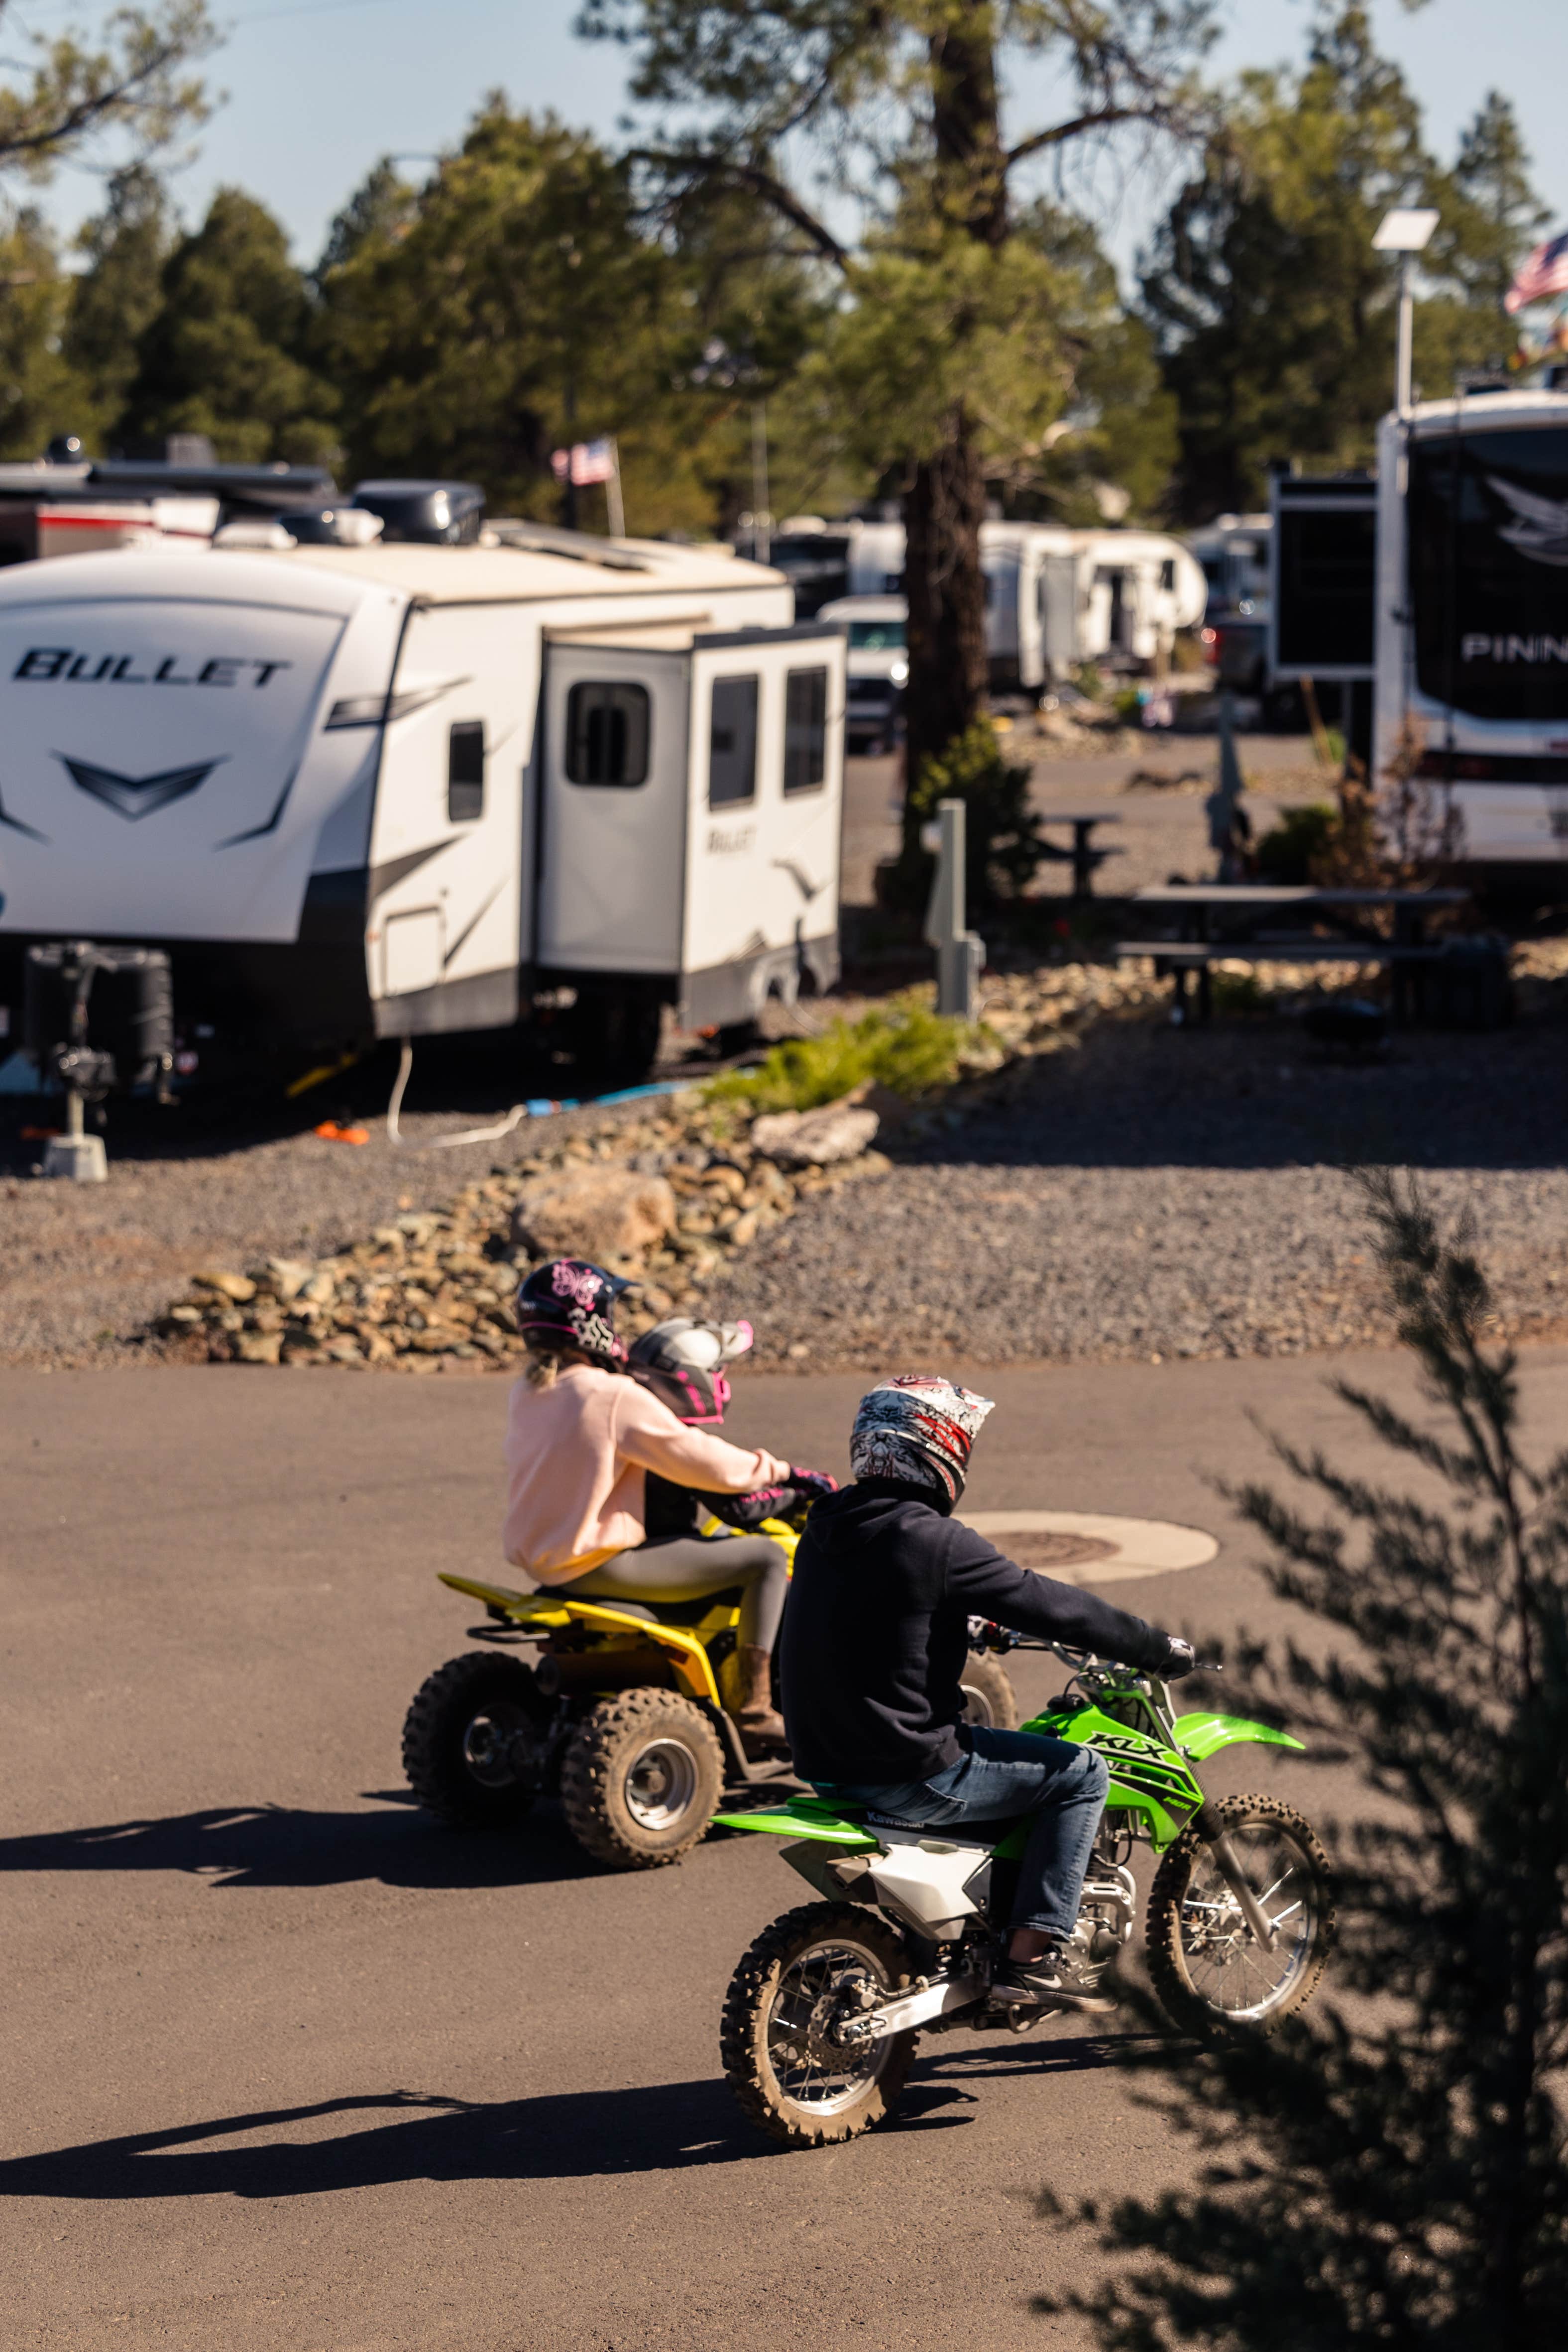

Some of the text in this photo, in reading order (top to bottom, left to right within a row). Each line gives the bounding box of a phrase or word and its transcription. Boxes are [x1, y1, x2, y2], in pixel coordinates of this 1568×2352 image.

[13, 648, 292, 688] BULLET
[1084, 1733, 1171, 1761] KLX
[867, 1810, 924, 1828] Kawasaki
